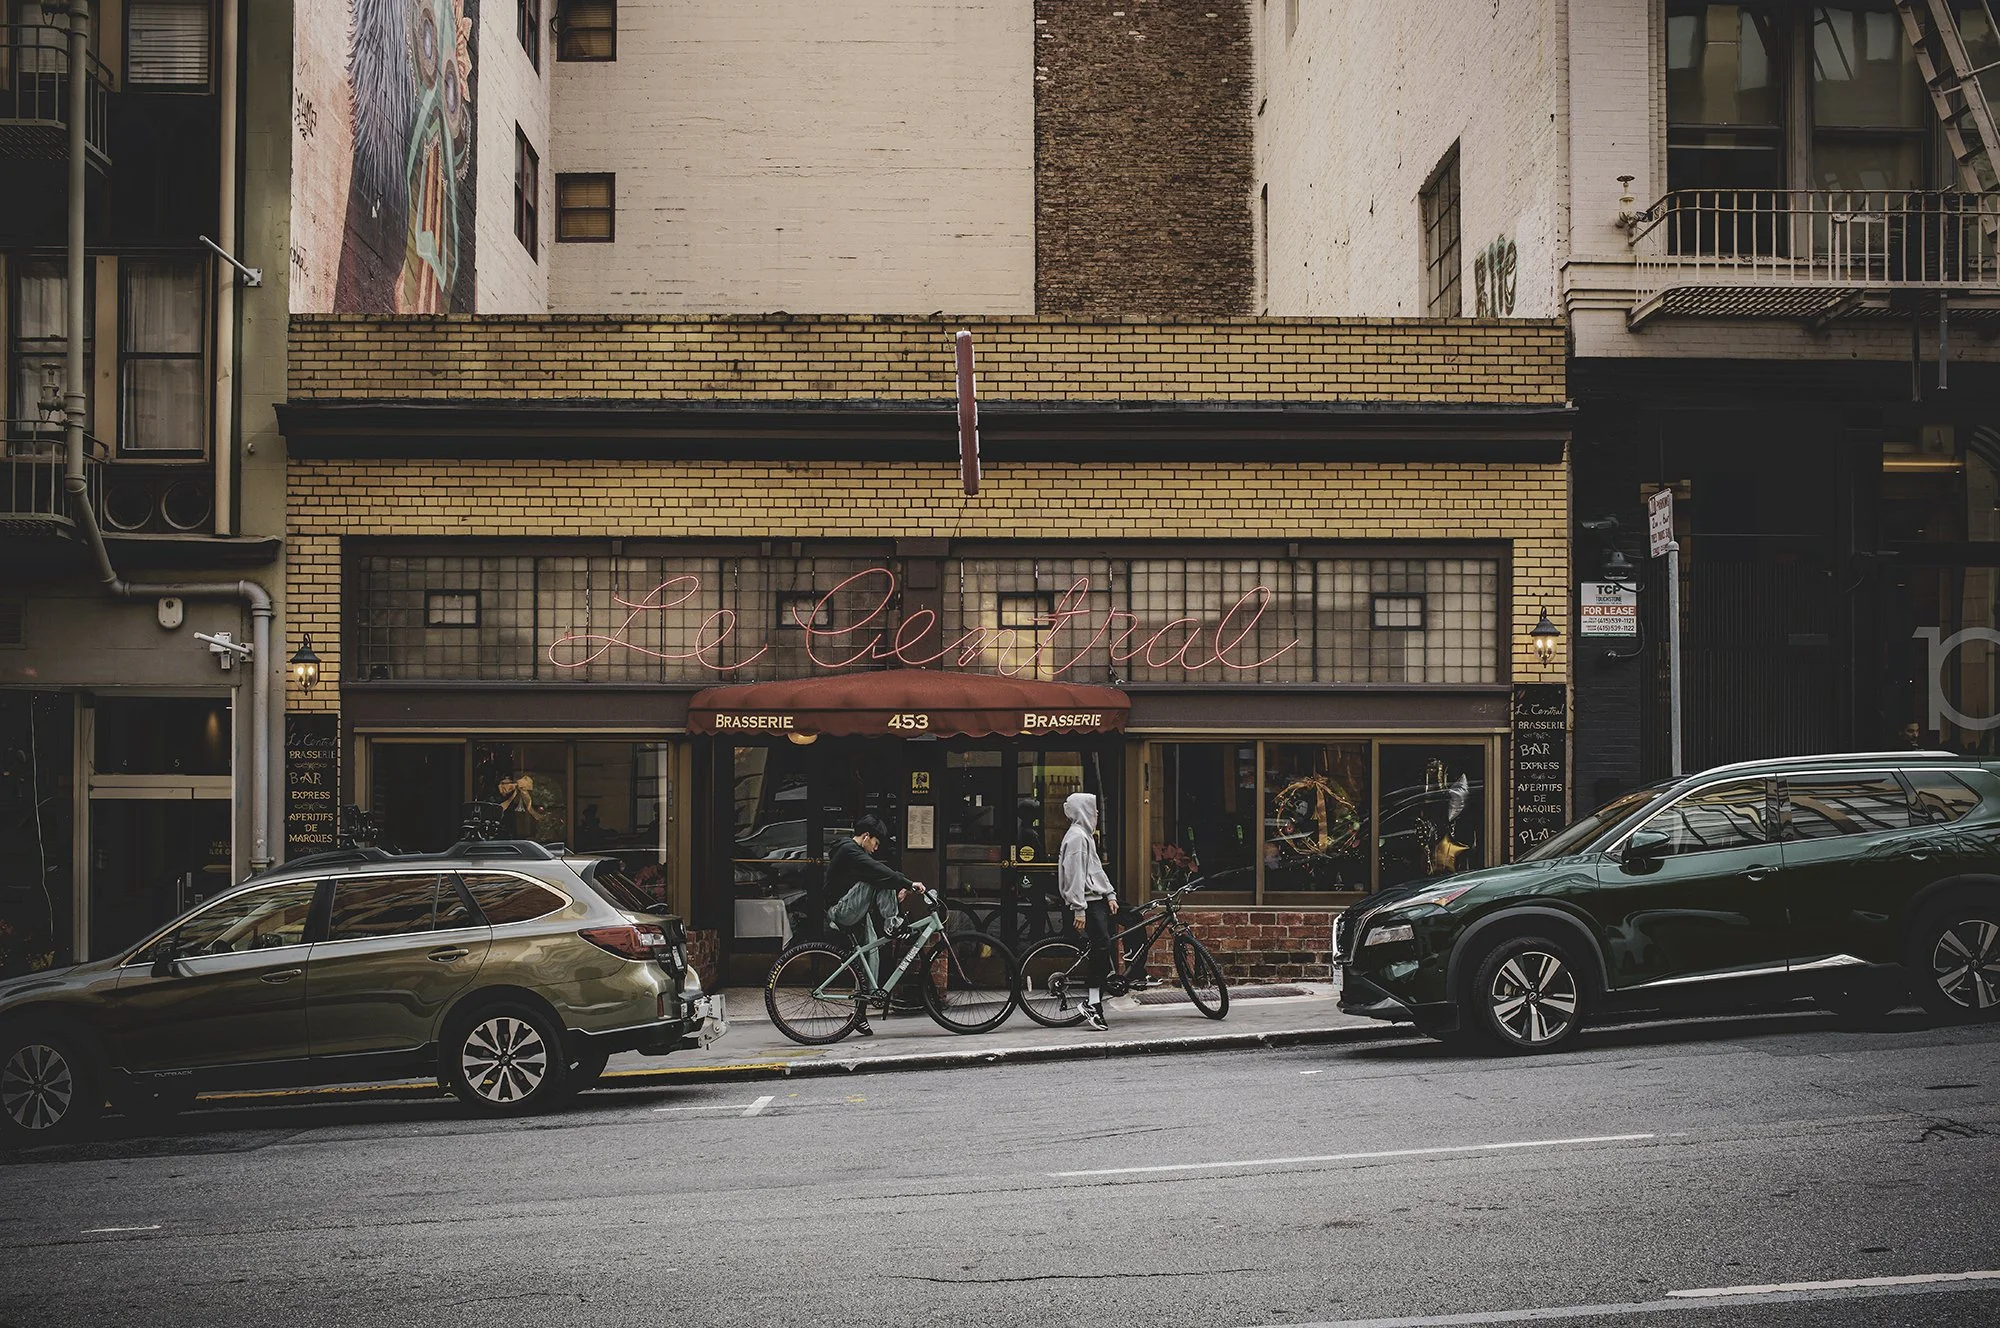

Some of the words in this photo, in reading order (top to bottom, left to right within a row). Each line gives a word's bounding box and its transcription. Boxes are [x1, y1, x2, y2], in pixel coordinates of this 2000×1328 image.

[1583, 606, 1602, 616] FOR
[1603, 606, 1635, 616] LEASE
[548, 575, 768, 670] Le
[792, 567, 1300, 677] Central
[715, 713, 794, 729] BRASSERIE
[887, 713, 930, 729] 453
[1023, 713, 1102, 728] BRASSERIE
[1518, 720, 1566, 730] BRASSERIE
[1520, 742, 1551, 757] BAR
[1520, 761, 1560, 771] EXPRESS
[289, 771, 322, 785] BAR
[1517, 783, 1563, 792] APERITIFS
[291, 790, 331, 800] EXPRESS
[1533, 794, 1547, 803] DE
[1518, 804, 1562, 814] MARQUES
[288, 812, 334, 821] APERITIFS
[304, 823, 318, 832] DE
[288, 833, 333, 843] MARQUES
